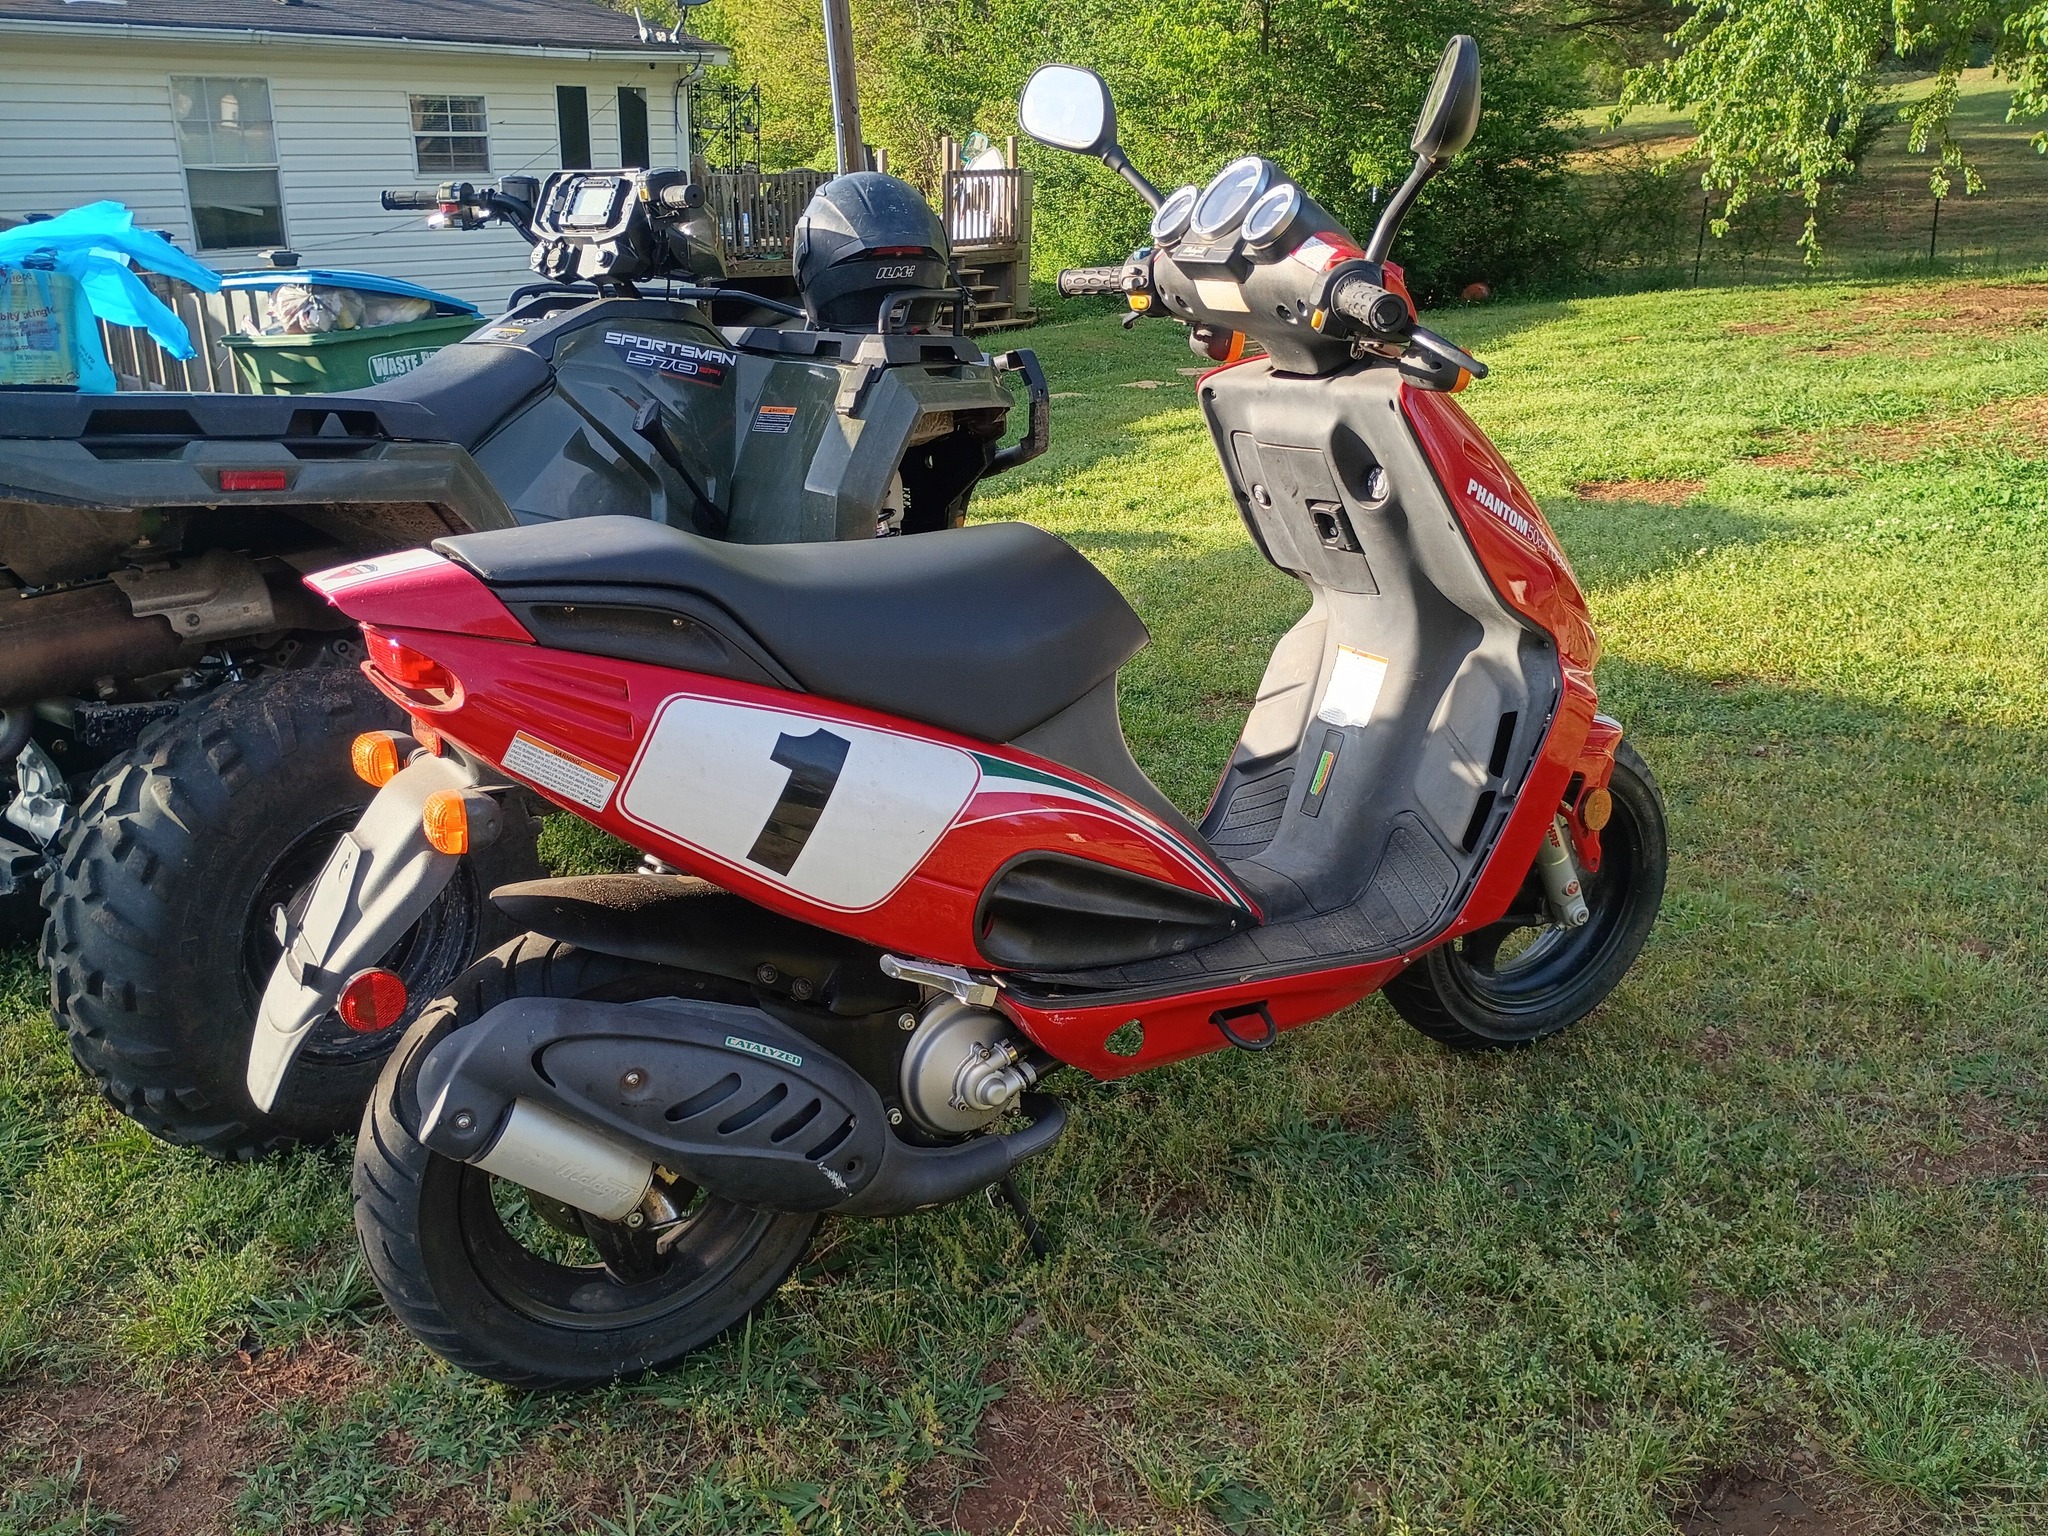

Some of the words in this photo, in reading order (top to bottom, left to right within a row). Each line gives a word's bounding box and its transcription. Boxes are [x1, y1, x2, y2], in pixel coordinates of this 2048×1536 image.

[604, 331, 738, 367] SPORTSMAN
[625, 350, 698, 375] 570
[1466, 478, 1529, 536] PHANTOM
[745, 727, 851, 877] 1
[726, 1037, 801, 1065] CATALYZED
